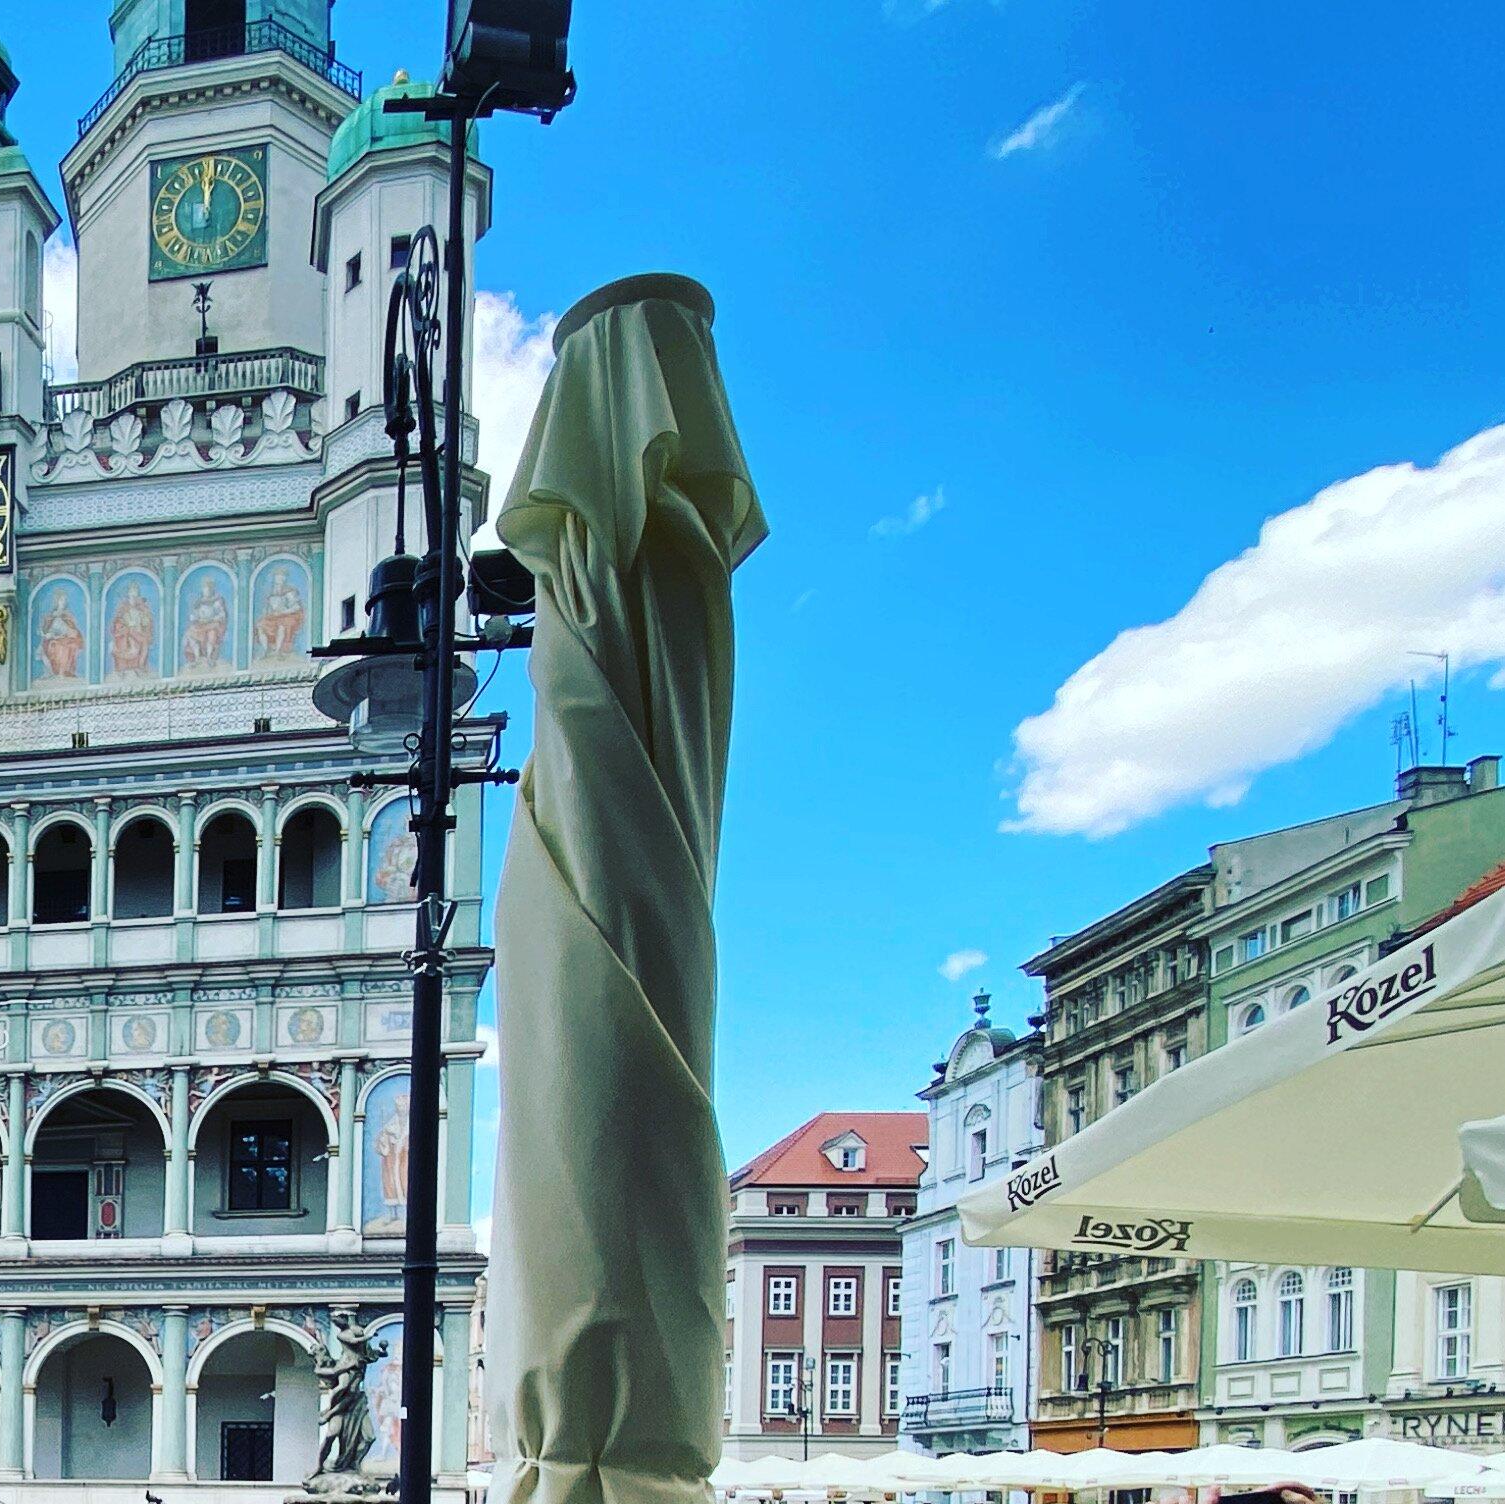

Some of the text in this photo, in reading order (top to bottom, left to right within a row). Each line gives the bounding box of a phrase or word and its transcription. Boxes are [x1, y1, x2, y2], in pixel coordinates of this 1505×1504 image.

[1326, 942, 1437, 1046] Kozel
[1007, 1154, 1062, 1213] Kozel
[1402, 1411, 1505, 1439] RYNE
